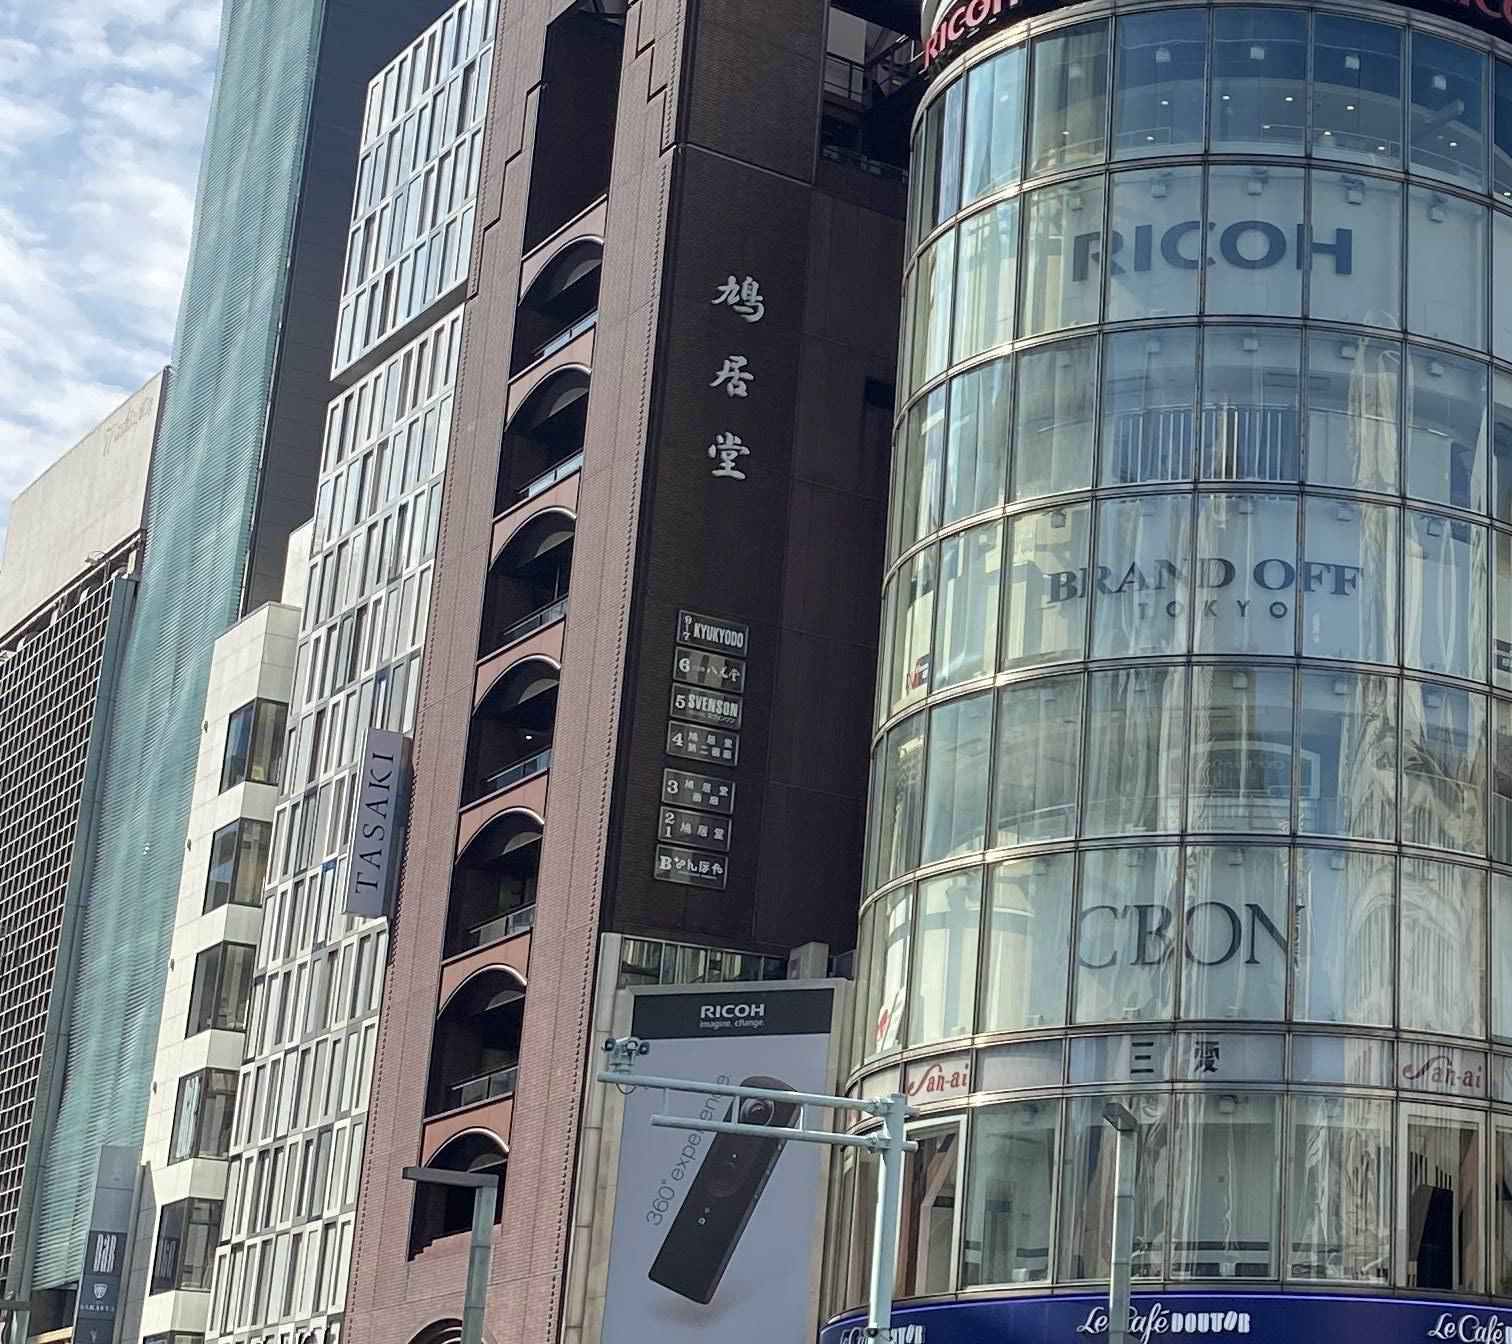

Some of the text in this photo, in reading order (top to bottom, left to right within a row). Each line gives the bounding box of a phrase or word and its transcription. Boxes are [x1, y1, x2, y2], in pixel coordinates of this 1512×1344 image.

[1073, 218, 1353, 282] RICOH
[707, 274, 765, 481] 鳩居堂
[1046, 558, 1364, 604] BRAND OFF
[1137, 599, 1289, 620] TOKYO
[693, 622, 744, 648] KYUKYODO
[678, 657, 691, 673] 6
[674, 694, 686, 709] 5
[687, 693, 739, 718] SVENSON
[672, 732, 684, 747] 4
[666, 779, 679, 794] 3
[354, 752, 394, 894] TASAKI
[664, 812, 675, 825] 2
[660, 855, 672, 871] B
[700, 1002, 765, 1019] RICOH
[907, 1063, 969, 1097] San-ai
[646, 1178, 676, 1226] 360°
[1077, 1305, 1110, 1335] Le
[1171, 1310, 1251, 1334] DOUTOR
[1427, 1312, 1457, 1340] Le
